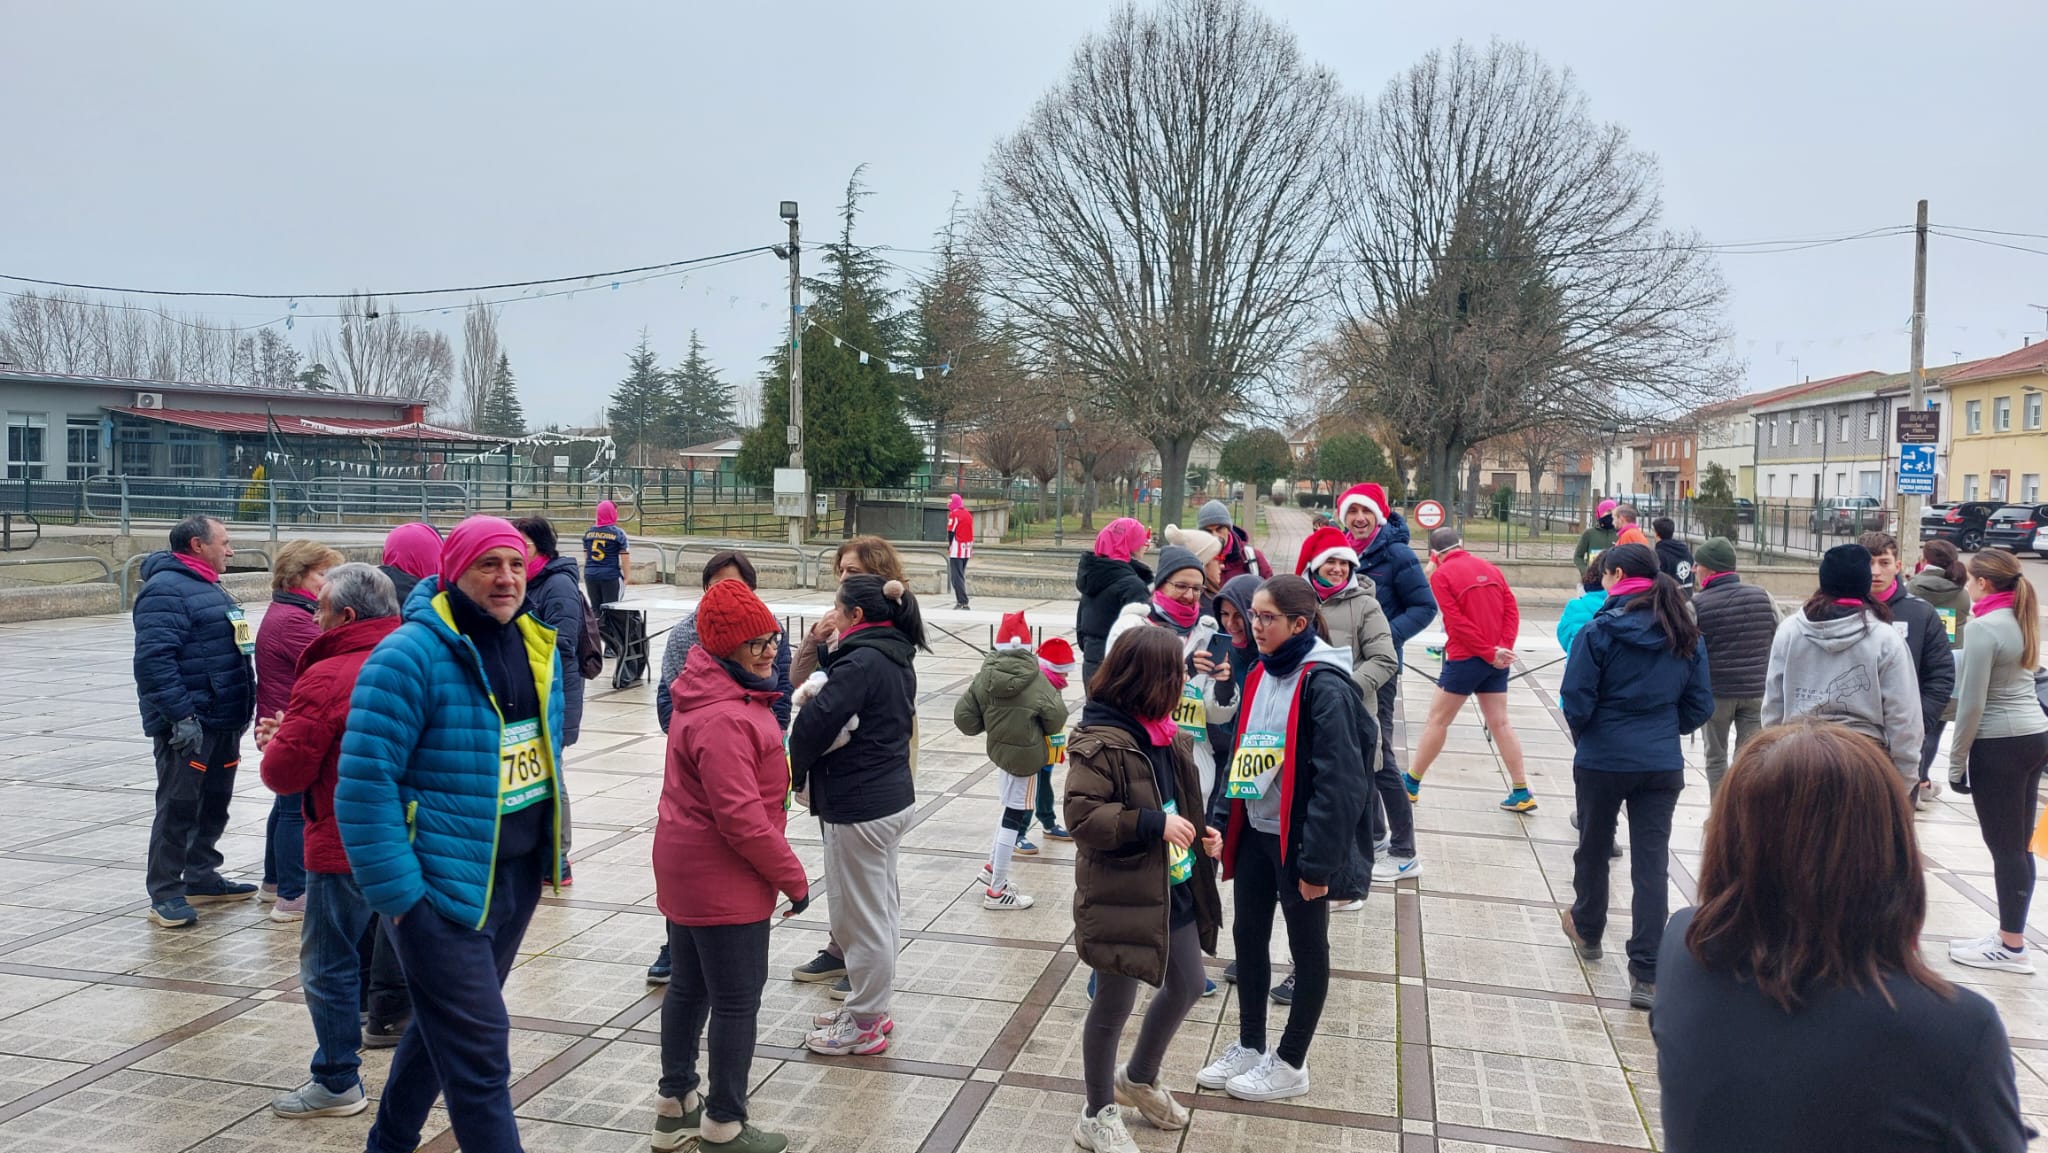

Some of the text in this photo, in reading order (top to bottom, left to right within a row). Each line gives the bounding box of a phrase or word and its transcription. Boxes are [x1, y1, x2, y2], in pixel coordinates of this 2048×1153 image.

[1909, 414, 1929, 422] BAR
[591, 539, 606, 561] 5
[503, 747, 541, 785] 768
